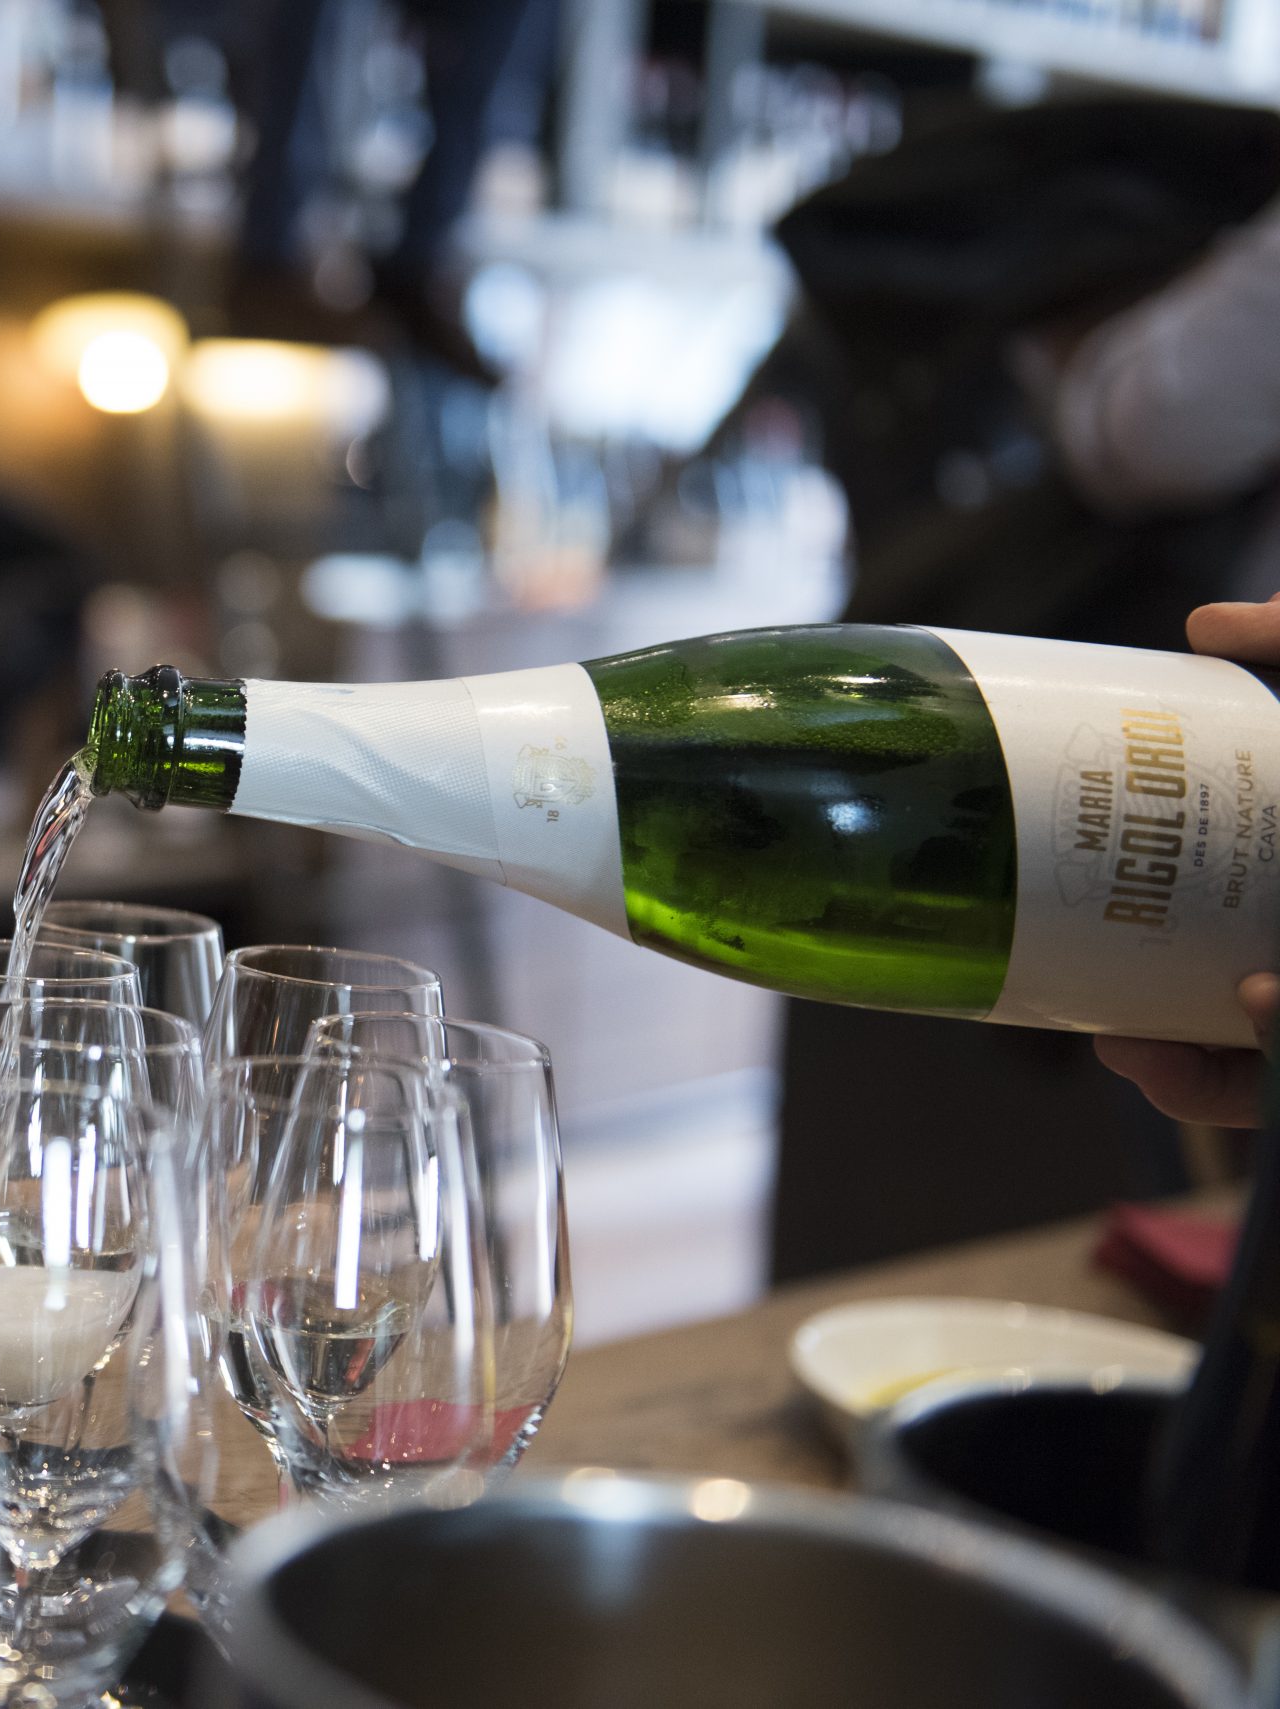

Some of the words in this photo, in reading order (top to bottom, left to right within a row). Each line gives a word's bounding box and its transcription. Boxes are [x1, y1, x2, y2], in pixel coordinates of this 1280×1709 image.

[1121, 708, 1186, 799] ORDI
[546, 810, 560, 823] 18
[1074, 770, 1113, 852] MARIA
[1200, 784, 1210, 813] 1897
[1235, 749, 1254, 839] NATURE
[1194, 840, 1207, 867] DES
[1198, 816, 1209, 835] DE
[1259, 804, 1277, 863] CAVA
[1103, 811, 1186, 927] RIGOL
[1223, 848, 1249, 909] BRUT
